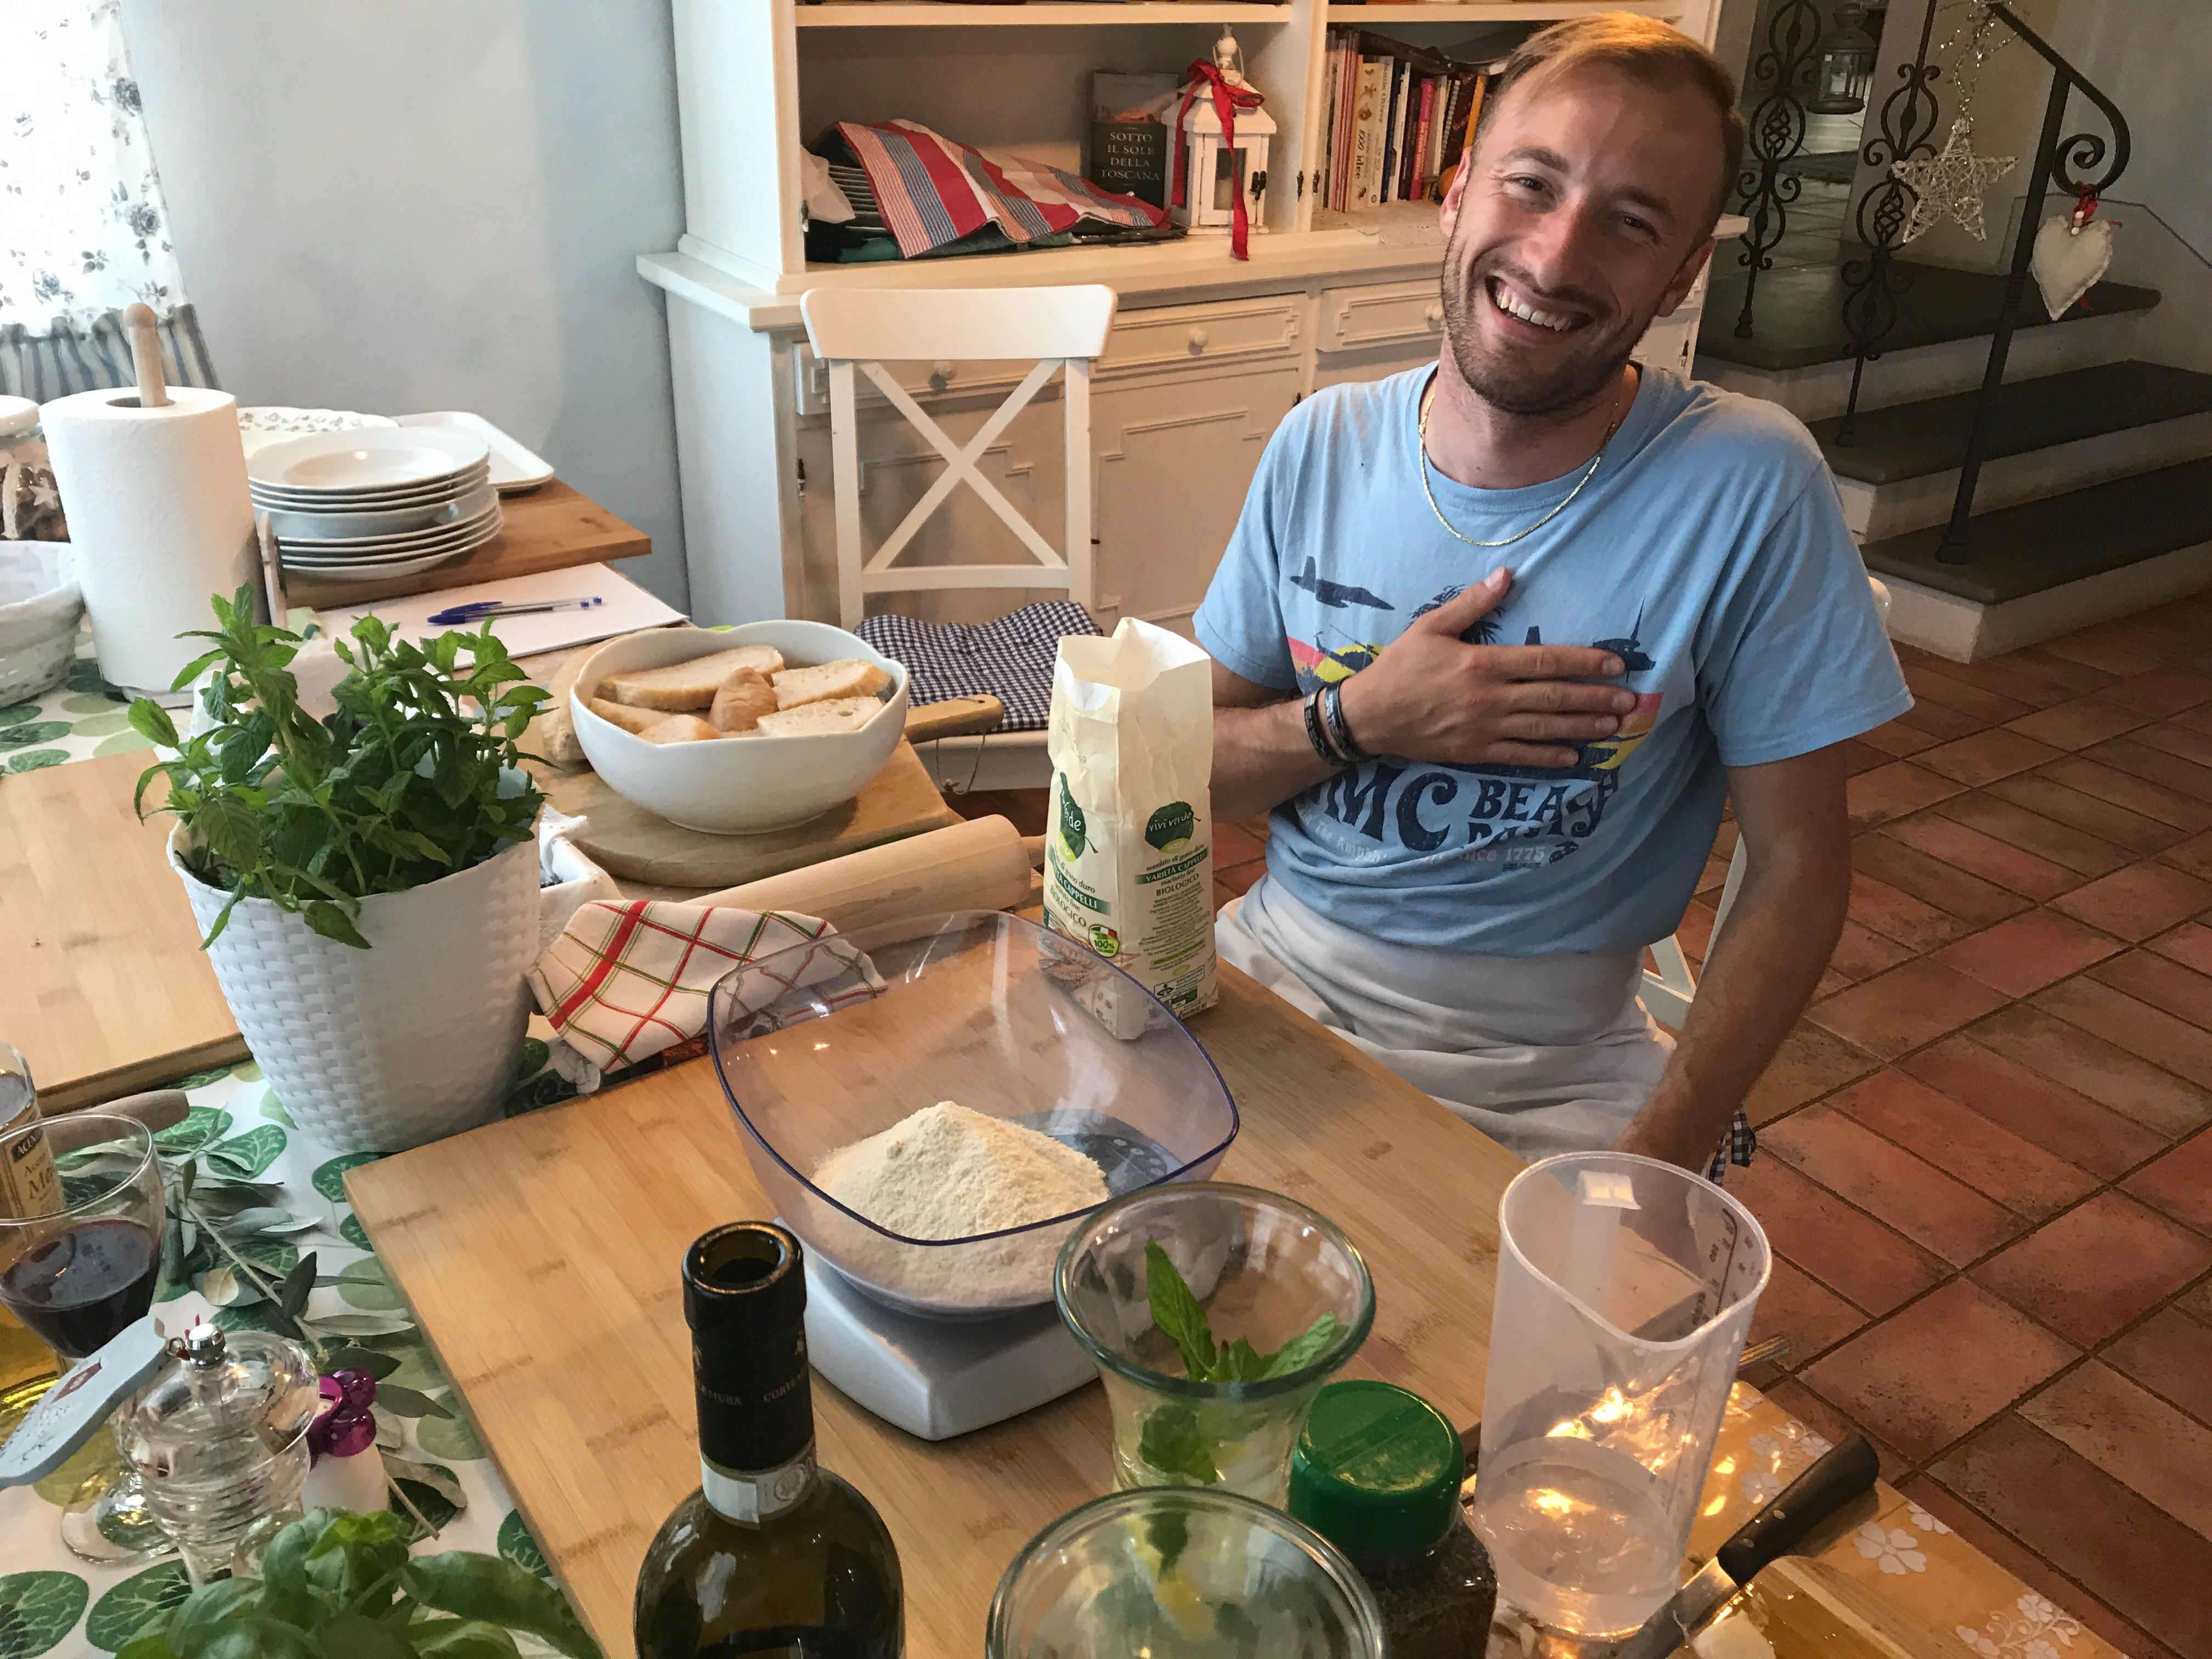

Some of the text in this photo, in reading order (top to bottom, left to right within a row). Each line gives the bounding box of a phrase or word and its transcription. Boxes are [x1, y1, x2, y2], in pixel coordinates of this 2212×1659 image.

[1109, 131, 1153, 144] SOTTO
[1357, 129, 1365, 151] 1000
[1107, 144, 1155, 155] IL SOLE
[1110, 157, 1151, 168] DELLA
[1101, 169, 1161, 181] TOSCANA
[1149, 811, 1192, 832] vivi verde
[1505, 846, 1545, 862] 1775
[1146, 853, 1205, 882] VARIETÀ CAPPELLI
[1064, 867, 1078, 884] grano
[1079, 880, 1096, 894] duro
[1155, 872, 1199, 896] BIOLOGICO
[1064, 879, 1097, 910] CAPPELLI
[1050, 882, 1087, 928] BIOLOGICO
[1069, 899, 1081, 912] fine
[1093, 939, 1115, 949] 100%
